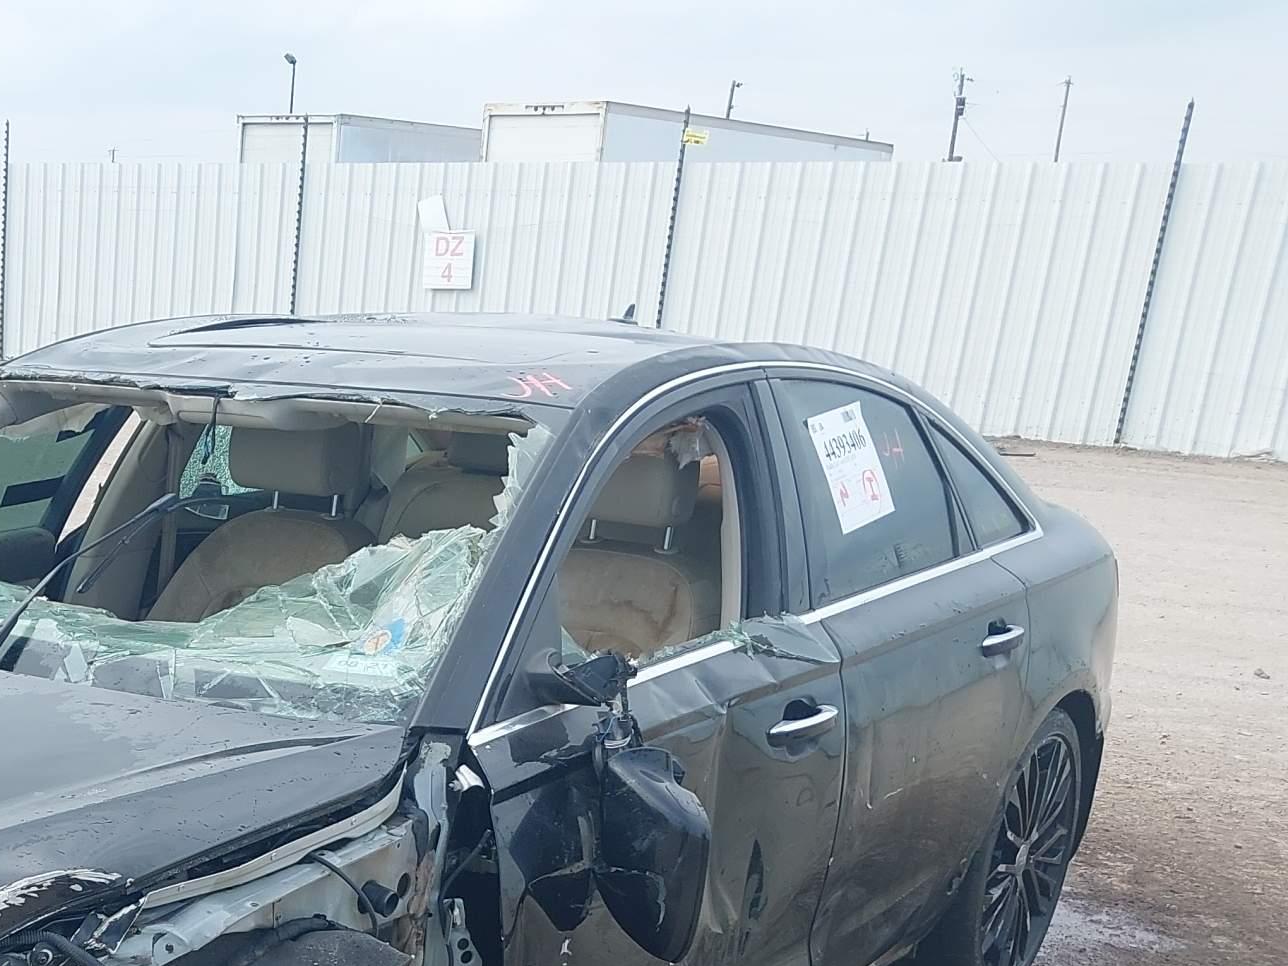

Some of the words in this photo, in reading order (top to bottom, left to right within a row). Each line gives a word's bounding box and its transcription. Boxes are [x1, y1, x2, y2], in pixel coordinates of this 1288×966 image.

[434, 236, 464, 257] DZ
[440, 262, 453, 283] 4
[823, 427, 867, 462] 44393406
